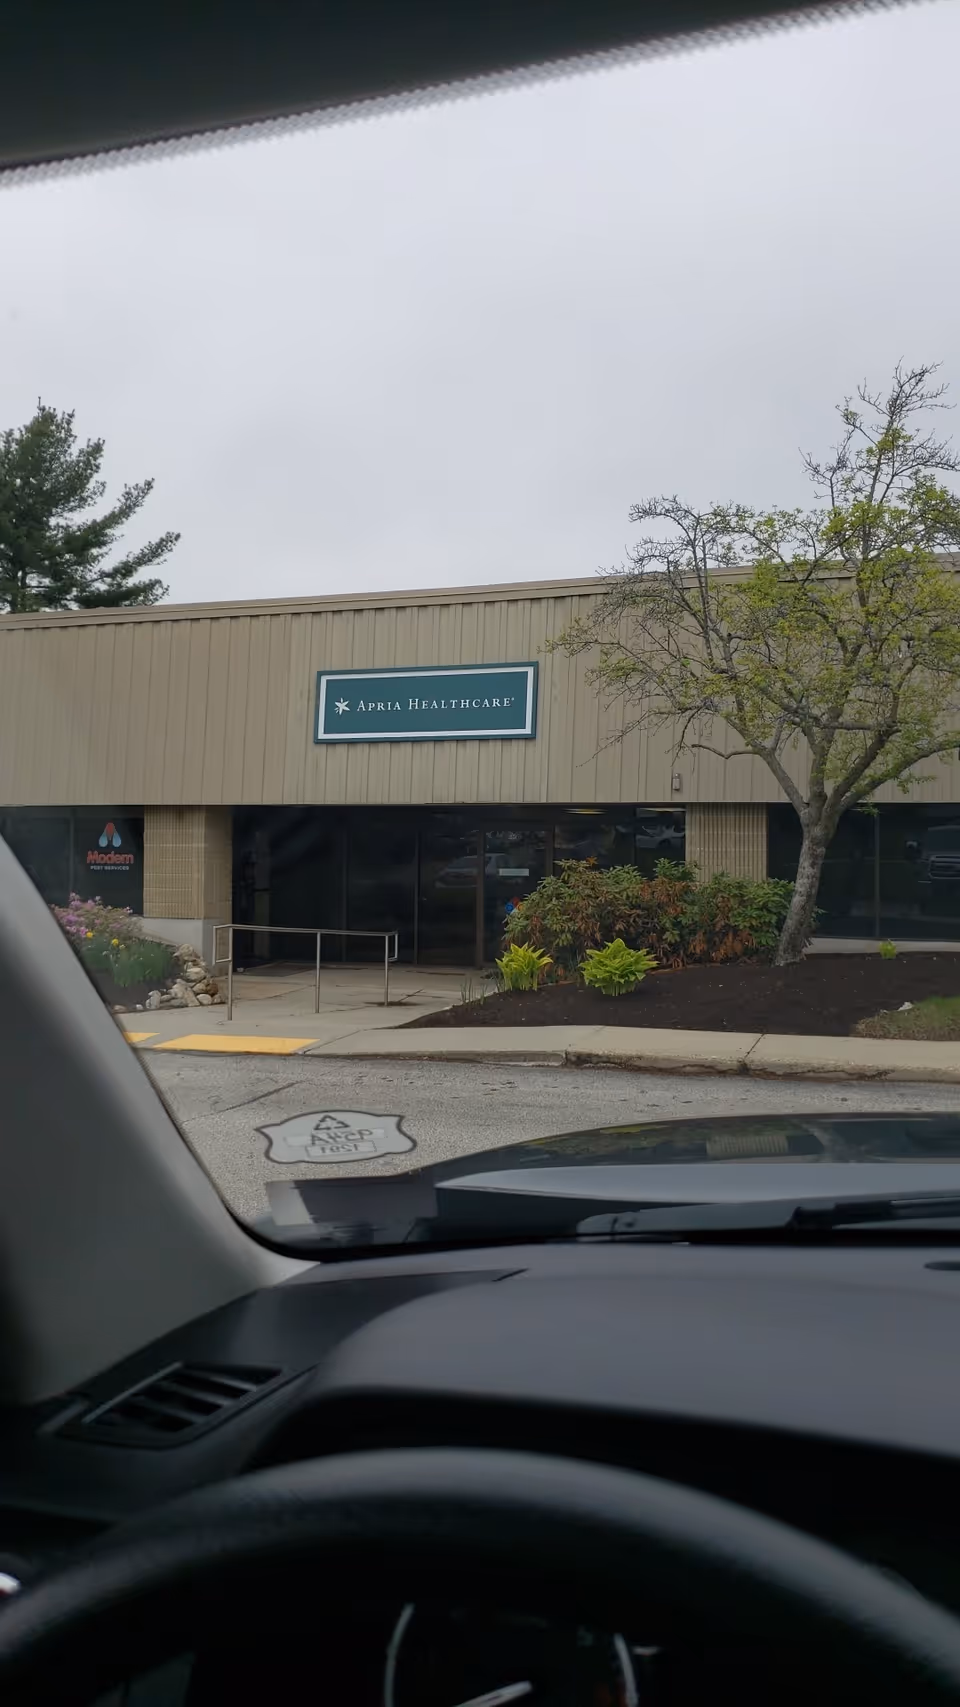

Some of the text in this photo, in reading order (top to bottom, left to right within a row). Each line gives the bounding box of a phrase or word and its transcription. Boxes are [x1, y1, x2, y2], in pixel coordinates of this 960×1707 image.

[357, 697, 511, 711] APRIA HEALTHCARE
[87, 851, 134, 864] Modern
